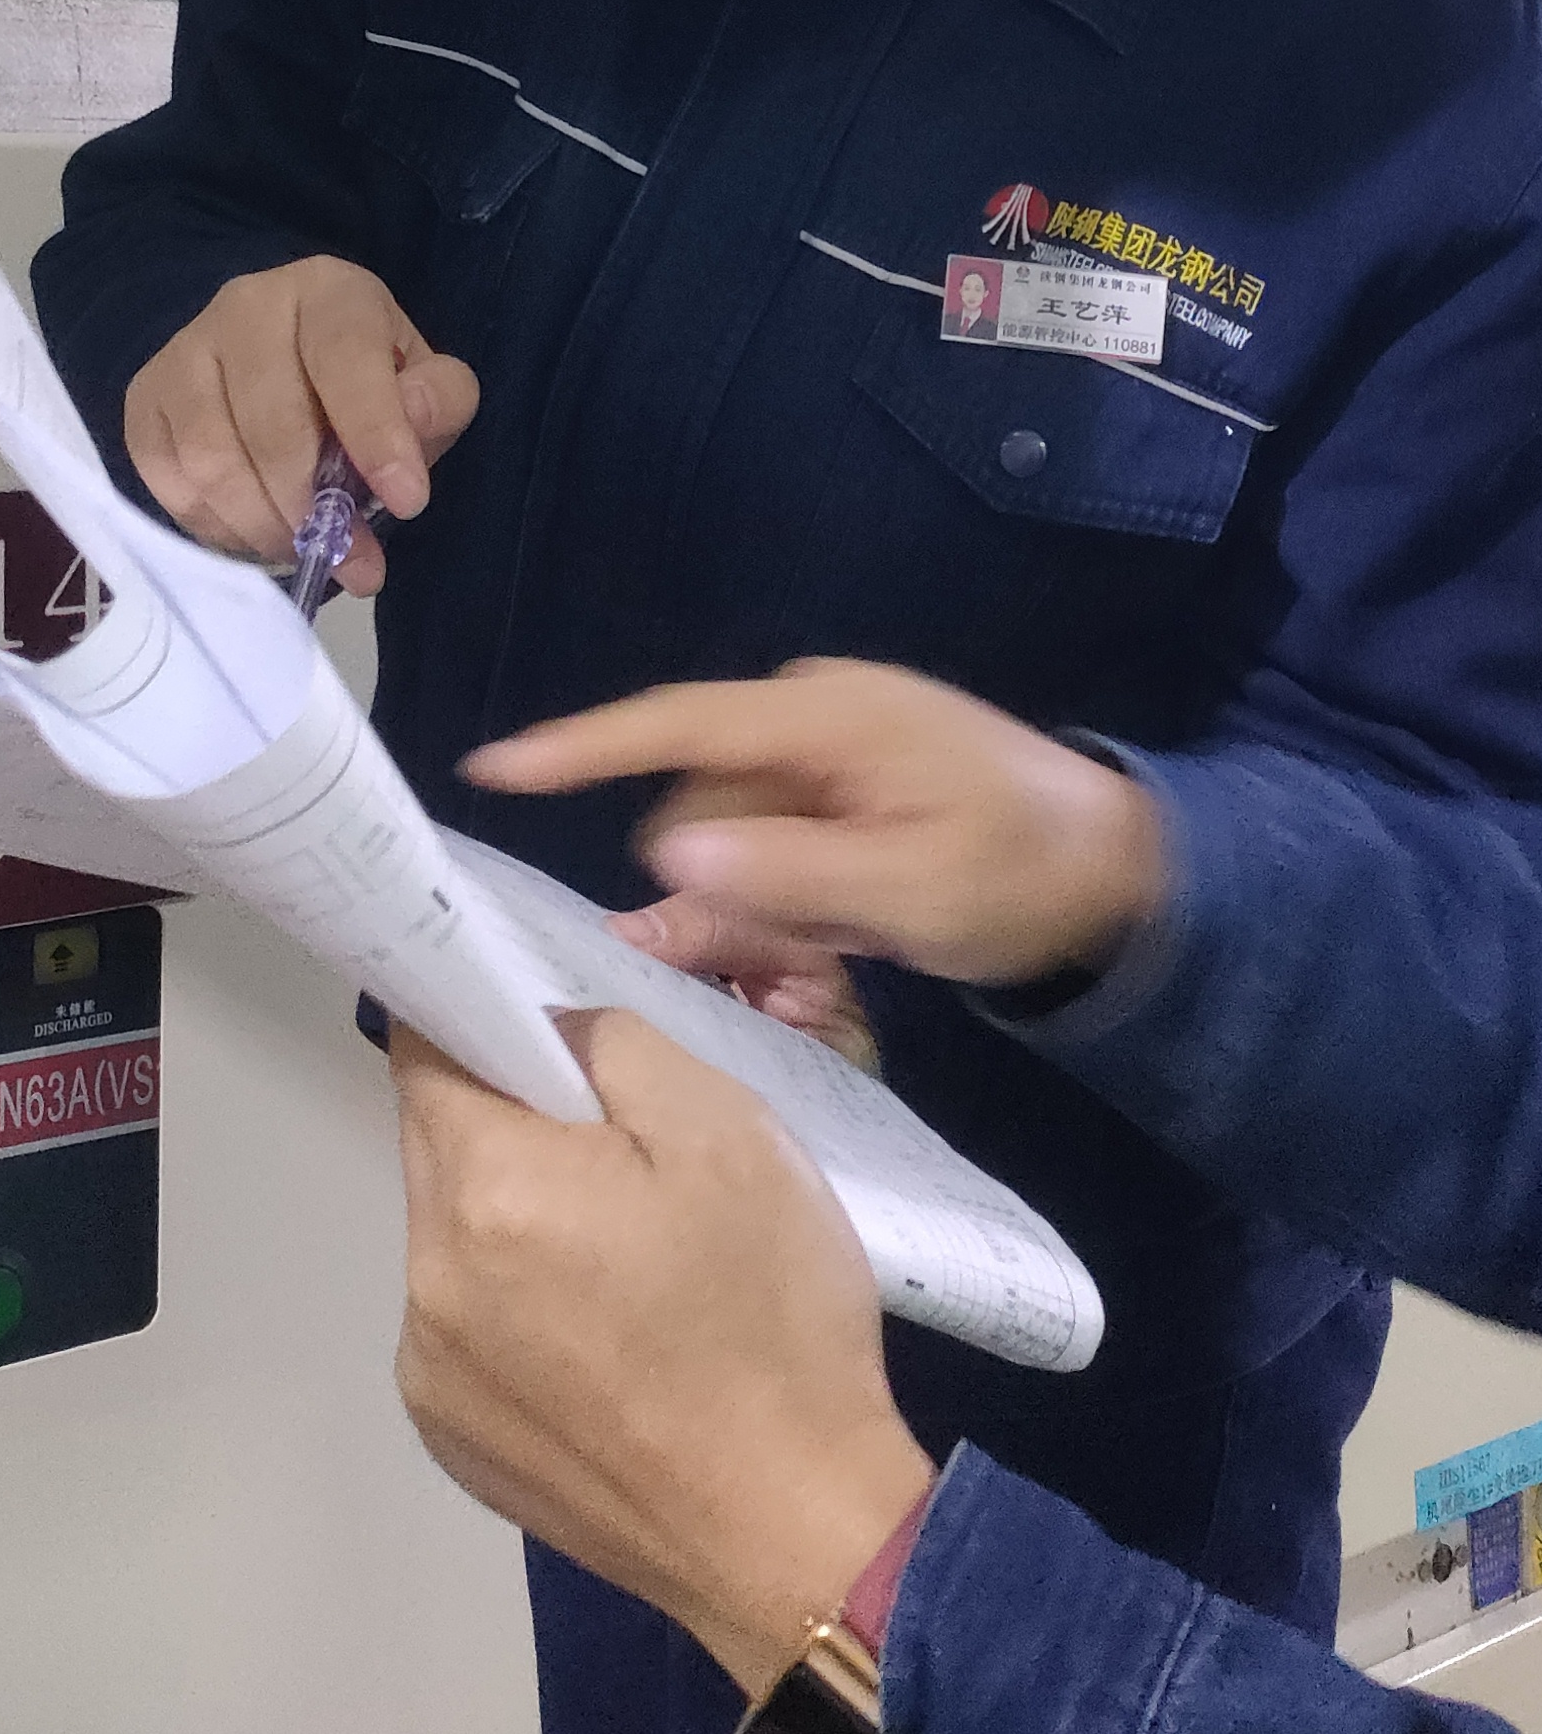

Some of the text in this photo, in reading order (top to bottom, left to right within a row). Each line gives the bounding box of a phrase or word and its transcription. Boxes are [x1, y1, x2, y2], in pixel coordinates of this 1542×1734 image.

[1046, 201, 1265, 315] 陕钢集团龙钢公司
[1039, 269, 1152, 295] 陕钢集团龙钢公司
[1036, 298, 1131, 326] 王艺萍
[1002, 323, 1158, 356] 能源管控中心 110881
[34, 1011, 113, 1038] DISCHARGED
